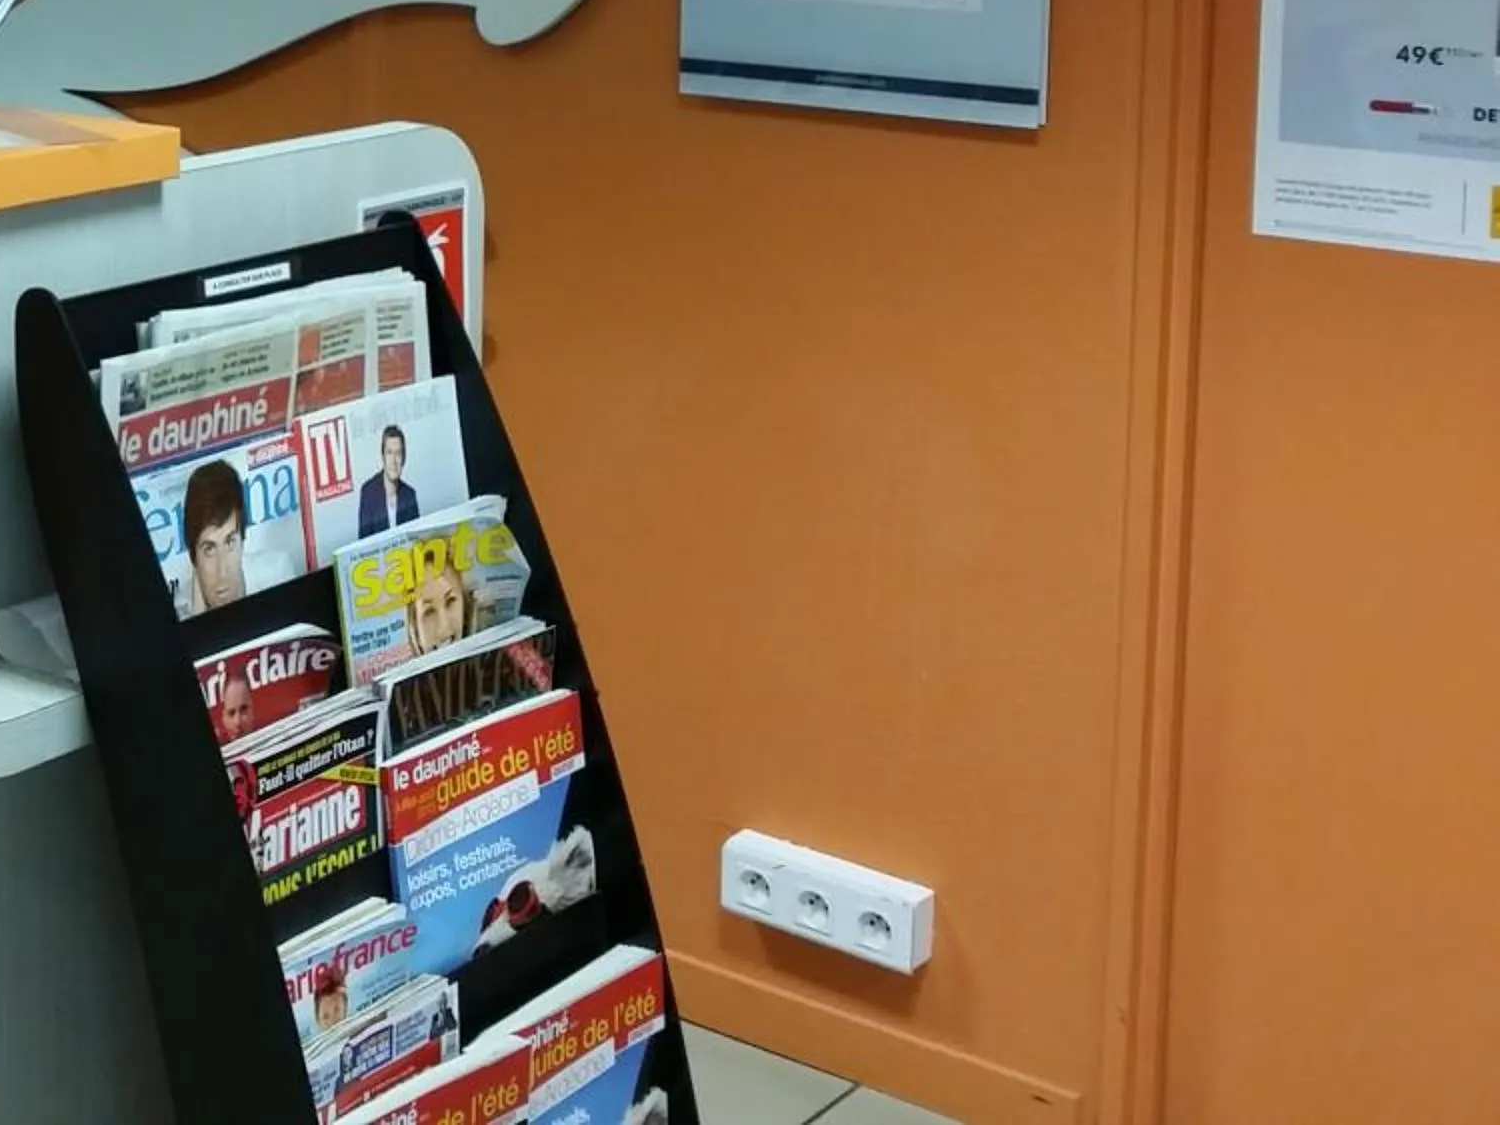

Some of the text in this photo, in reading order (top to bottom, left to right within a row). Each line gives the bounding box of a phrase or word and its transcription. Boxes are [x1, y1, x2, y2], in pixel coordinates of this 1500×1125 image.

[1396, 45, 1445, 66] 49€
[1472, 106, 1500, 123] DE
[120, 428, 143, 462] le
[148, 386, 269, 458] dauphiné
[310, 418, 348, 487] TV
[246, 641, 336, 691] claire
[393, 768, 409, 792] le
[412, 732, 482, 785] dauphiné
[436, 759, 495, 812] guide
[499, 746, 530, 778] de
[533, 723, 575, 766] l'été
[410, 881, 457, 912] expos,
[284, 923, 418, 1004] arie france
[583, 1018, 609, 1050] de
[613, 986, 656, 1034] l'été
